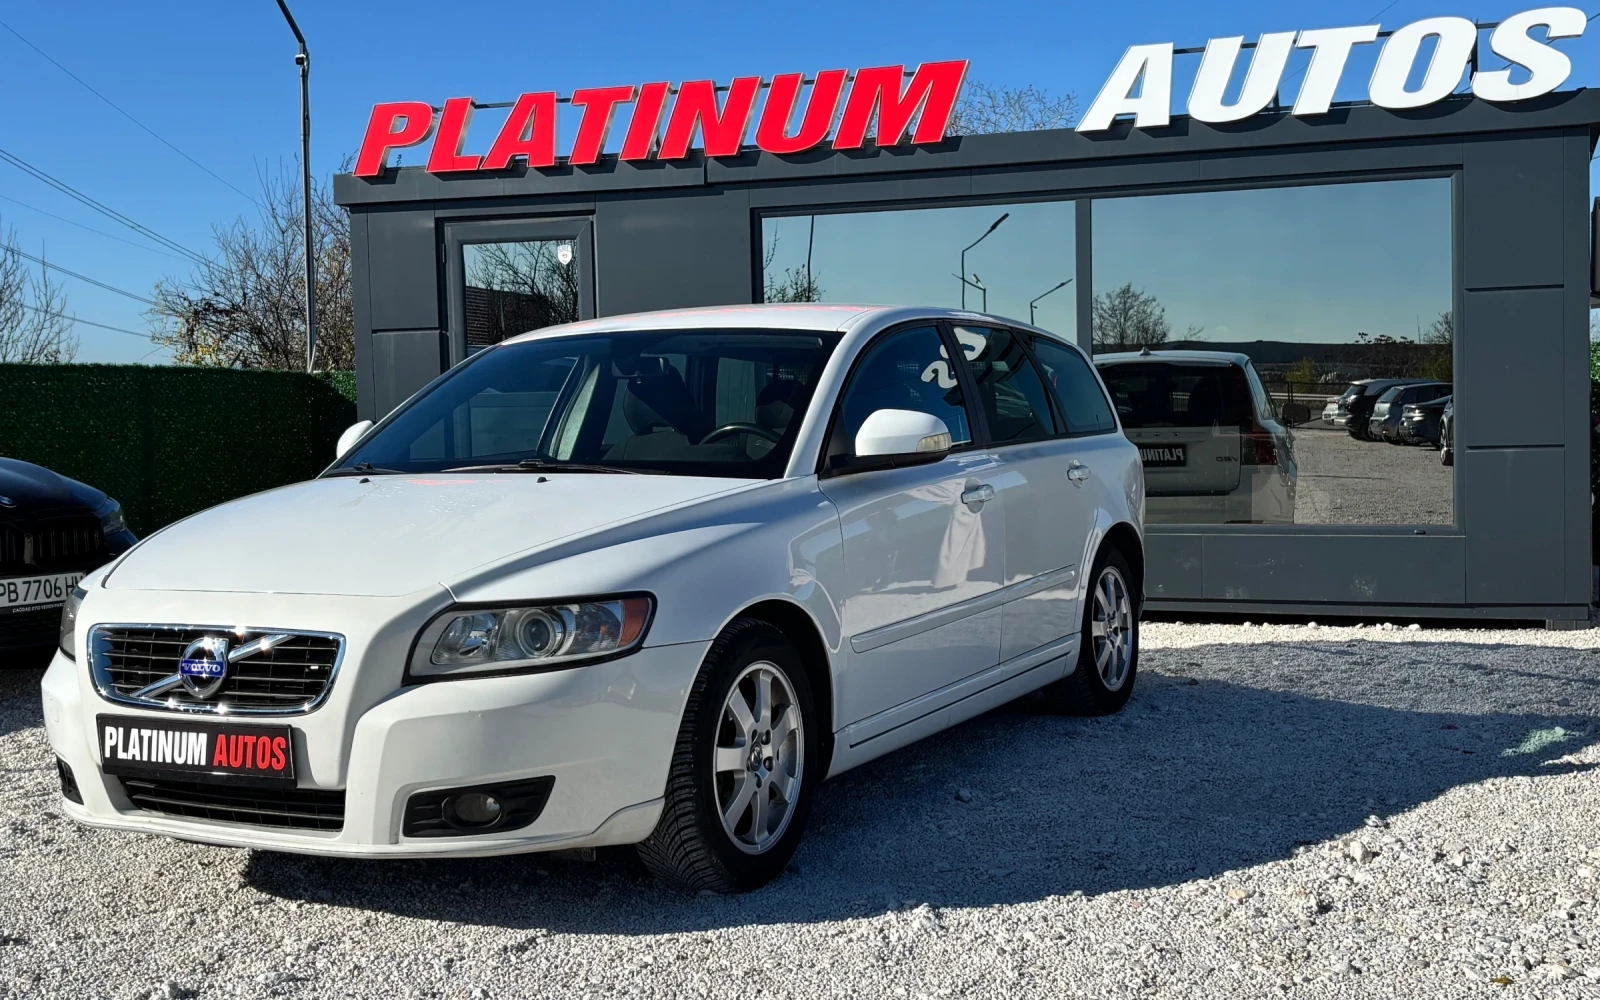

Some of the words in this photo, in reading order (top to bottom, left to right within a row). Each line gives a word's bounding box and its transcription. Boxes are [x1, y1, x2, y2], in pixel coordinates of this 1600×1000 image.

[354, 59, 969, 177] PLATINUM
[1074, 6, 1587, 132] AUTOS
[22, 578, 62, 601] 7706
[182, 663, 221, 673] VOLVO
[105, 726, 208, 766] PLATINUM
[213, 734, 287, 771] AUTOS
